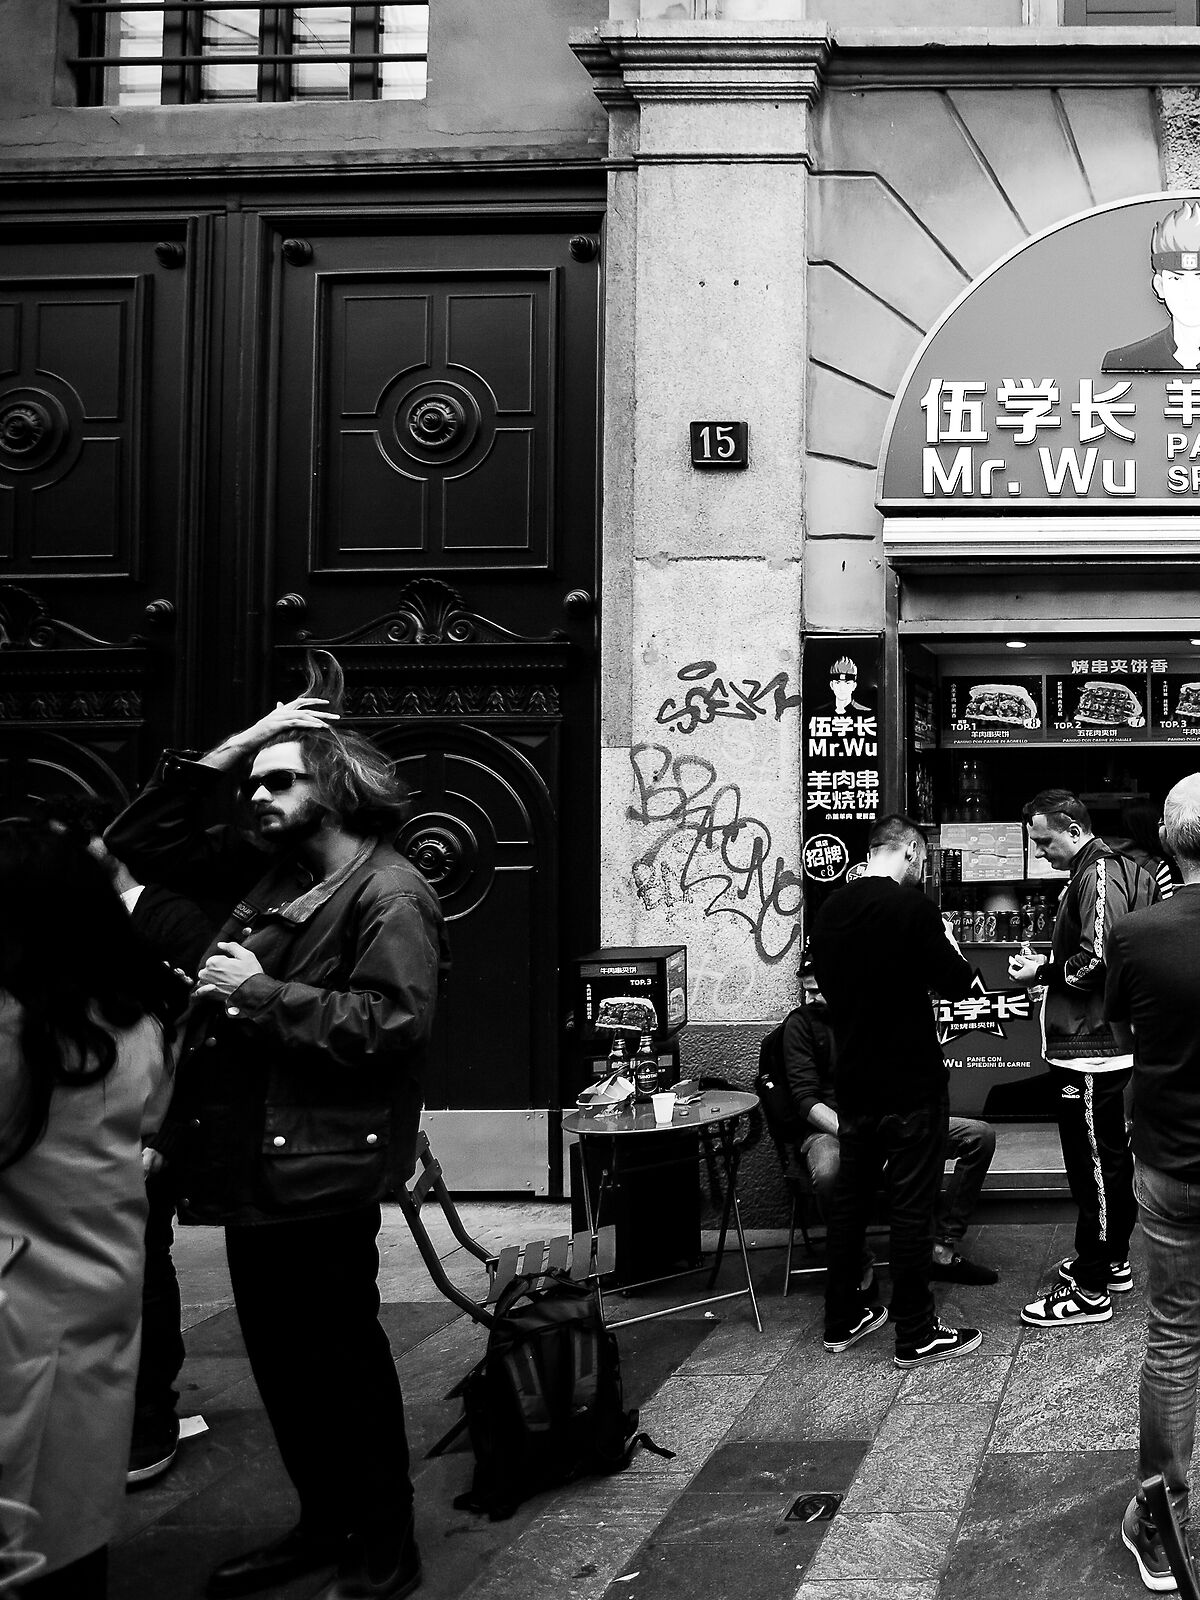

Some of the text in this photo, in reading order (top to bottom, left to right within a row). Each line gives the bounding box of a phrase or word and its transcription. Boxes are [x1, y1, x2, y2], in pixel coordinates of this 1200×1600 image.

[920, 378, 1136, 444] 伍学长
[700, 426, 735, 458] 15
[922, 446, 1136, 496] Mr. Wu
[809, 716, 877, 737] 伍学长
[809, 738, 878, 757] Mr.Wu
[807, 770, 879, 790] 羊肉串
[807, 790, 879, 810] 夹烧饼
[806, 845, 843, 868] 招牌
